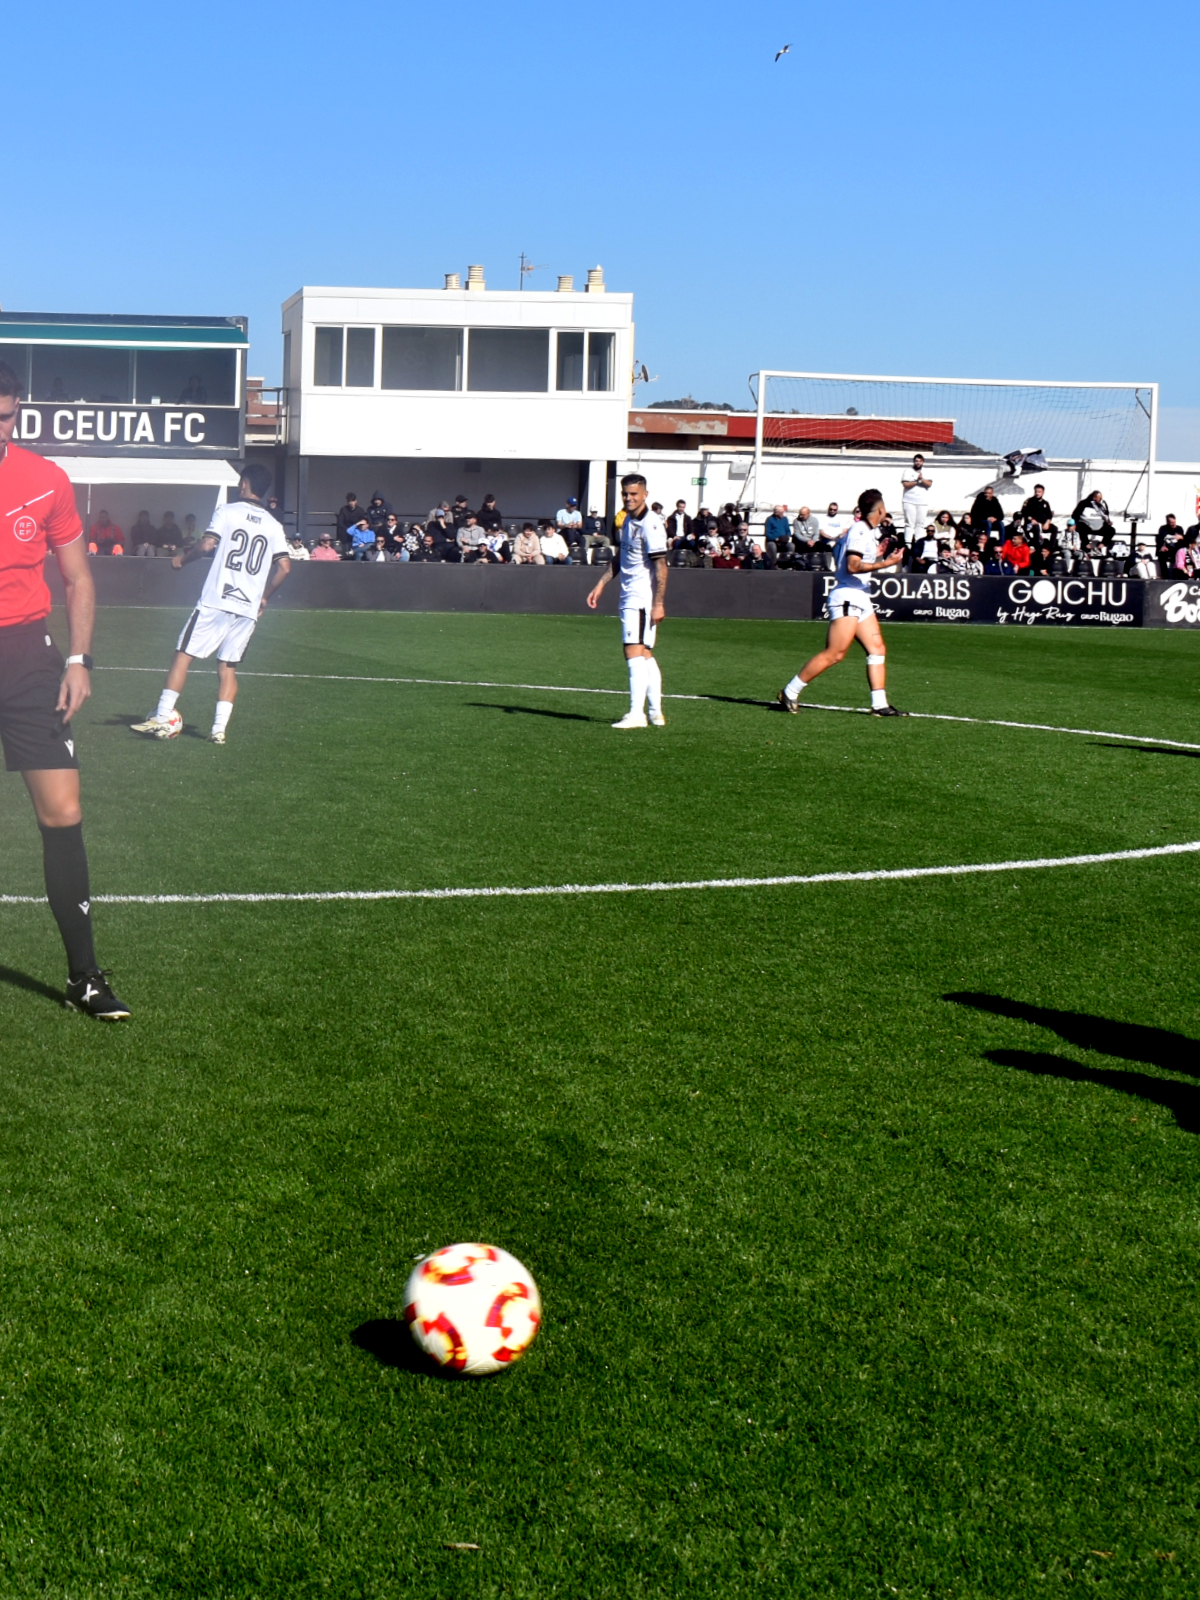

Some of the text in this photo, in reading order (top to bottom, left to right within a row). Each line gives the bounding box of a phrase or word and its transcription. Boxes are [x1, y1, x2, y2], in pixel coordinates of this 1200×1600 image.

[12, 409, 205, 443] D CEUTA FC
[225, 528, 268, 576] 20
[822, 576, 971, 601] PCOLABIS
[1008, 579, 1127, 606] GOICHU
[1100, 611, 1134, 624] Bugao
